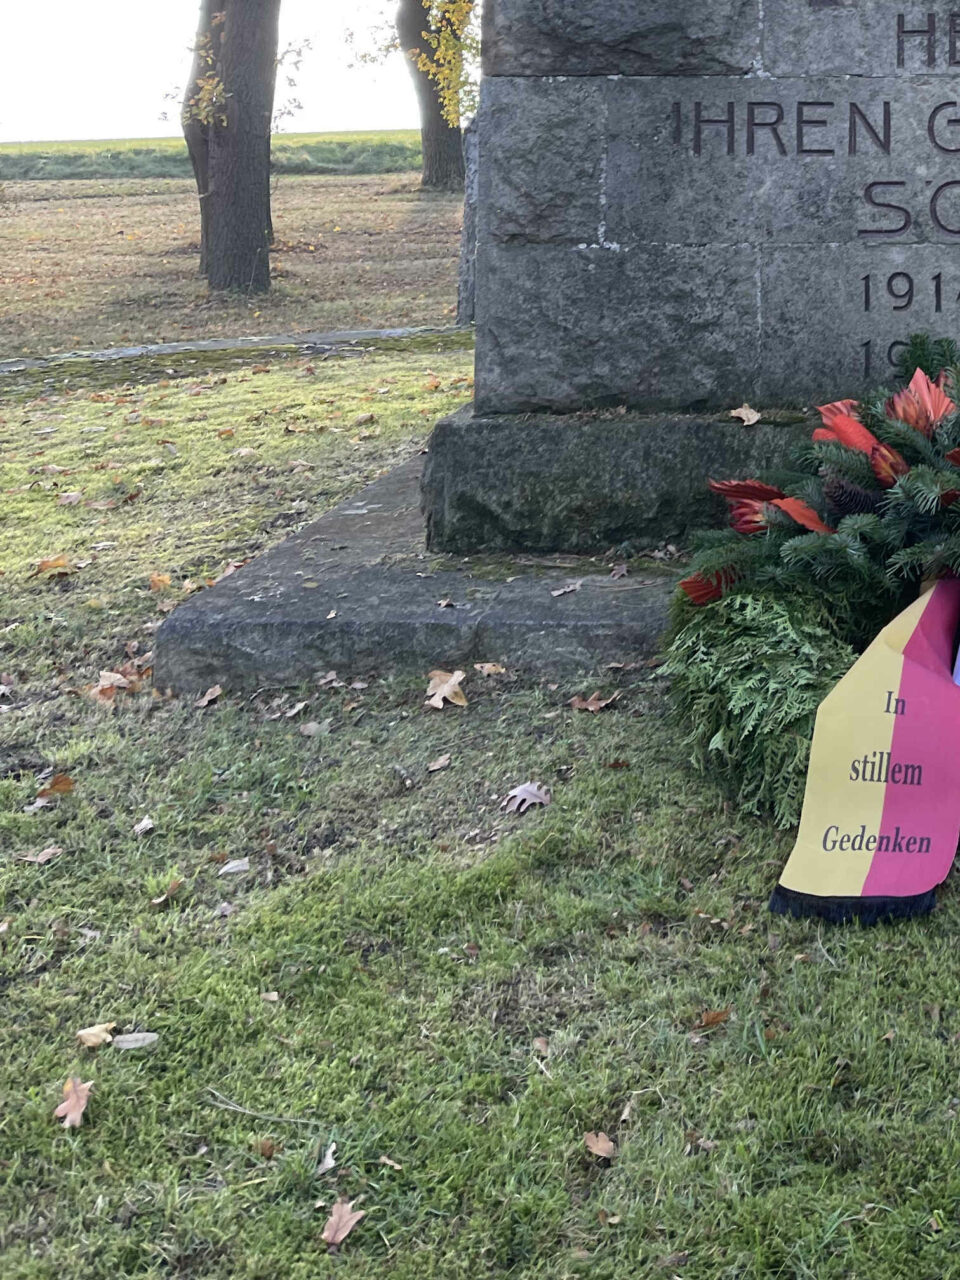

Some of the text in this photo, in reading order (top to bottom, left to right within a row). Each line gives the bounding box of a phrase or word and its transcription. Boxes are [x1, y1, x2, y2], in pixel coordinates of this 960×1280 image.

[672, 101, 892, 156] IHREN
[884, 690, 906, 716] In
[849, 751, 923, 786] stillem
[822, 825, 932, 854] Gedenken
